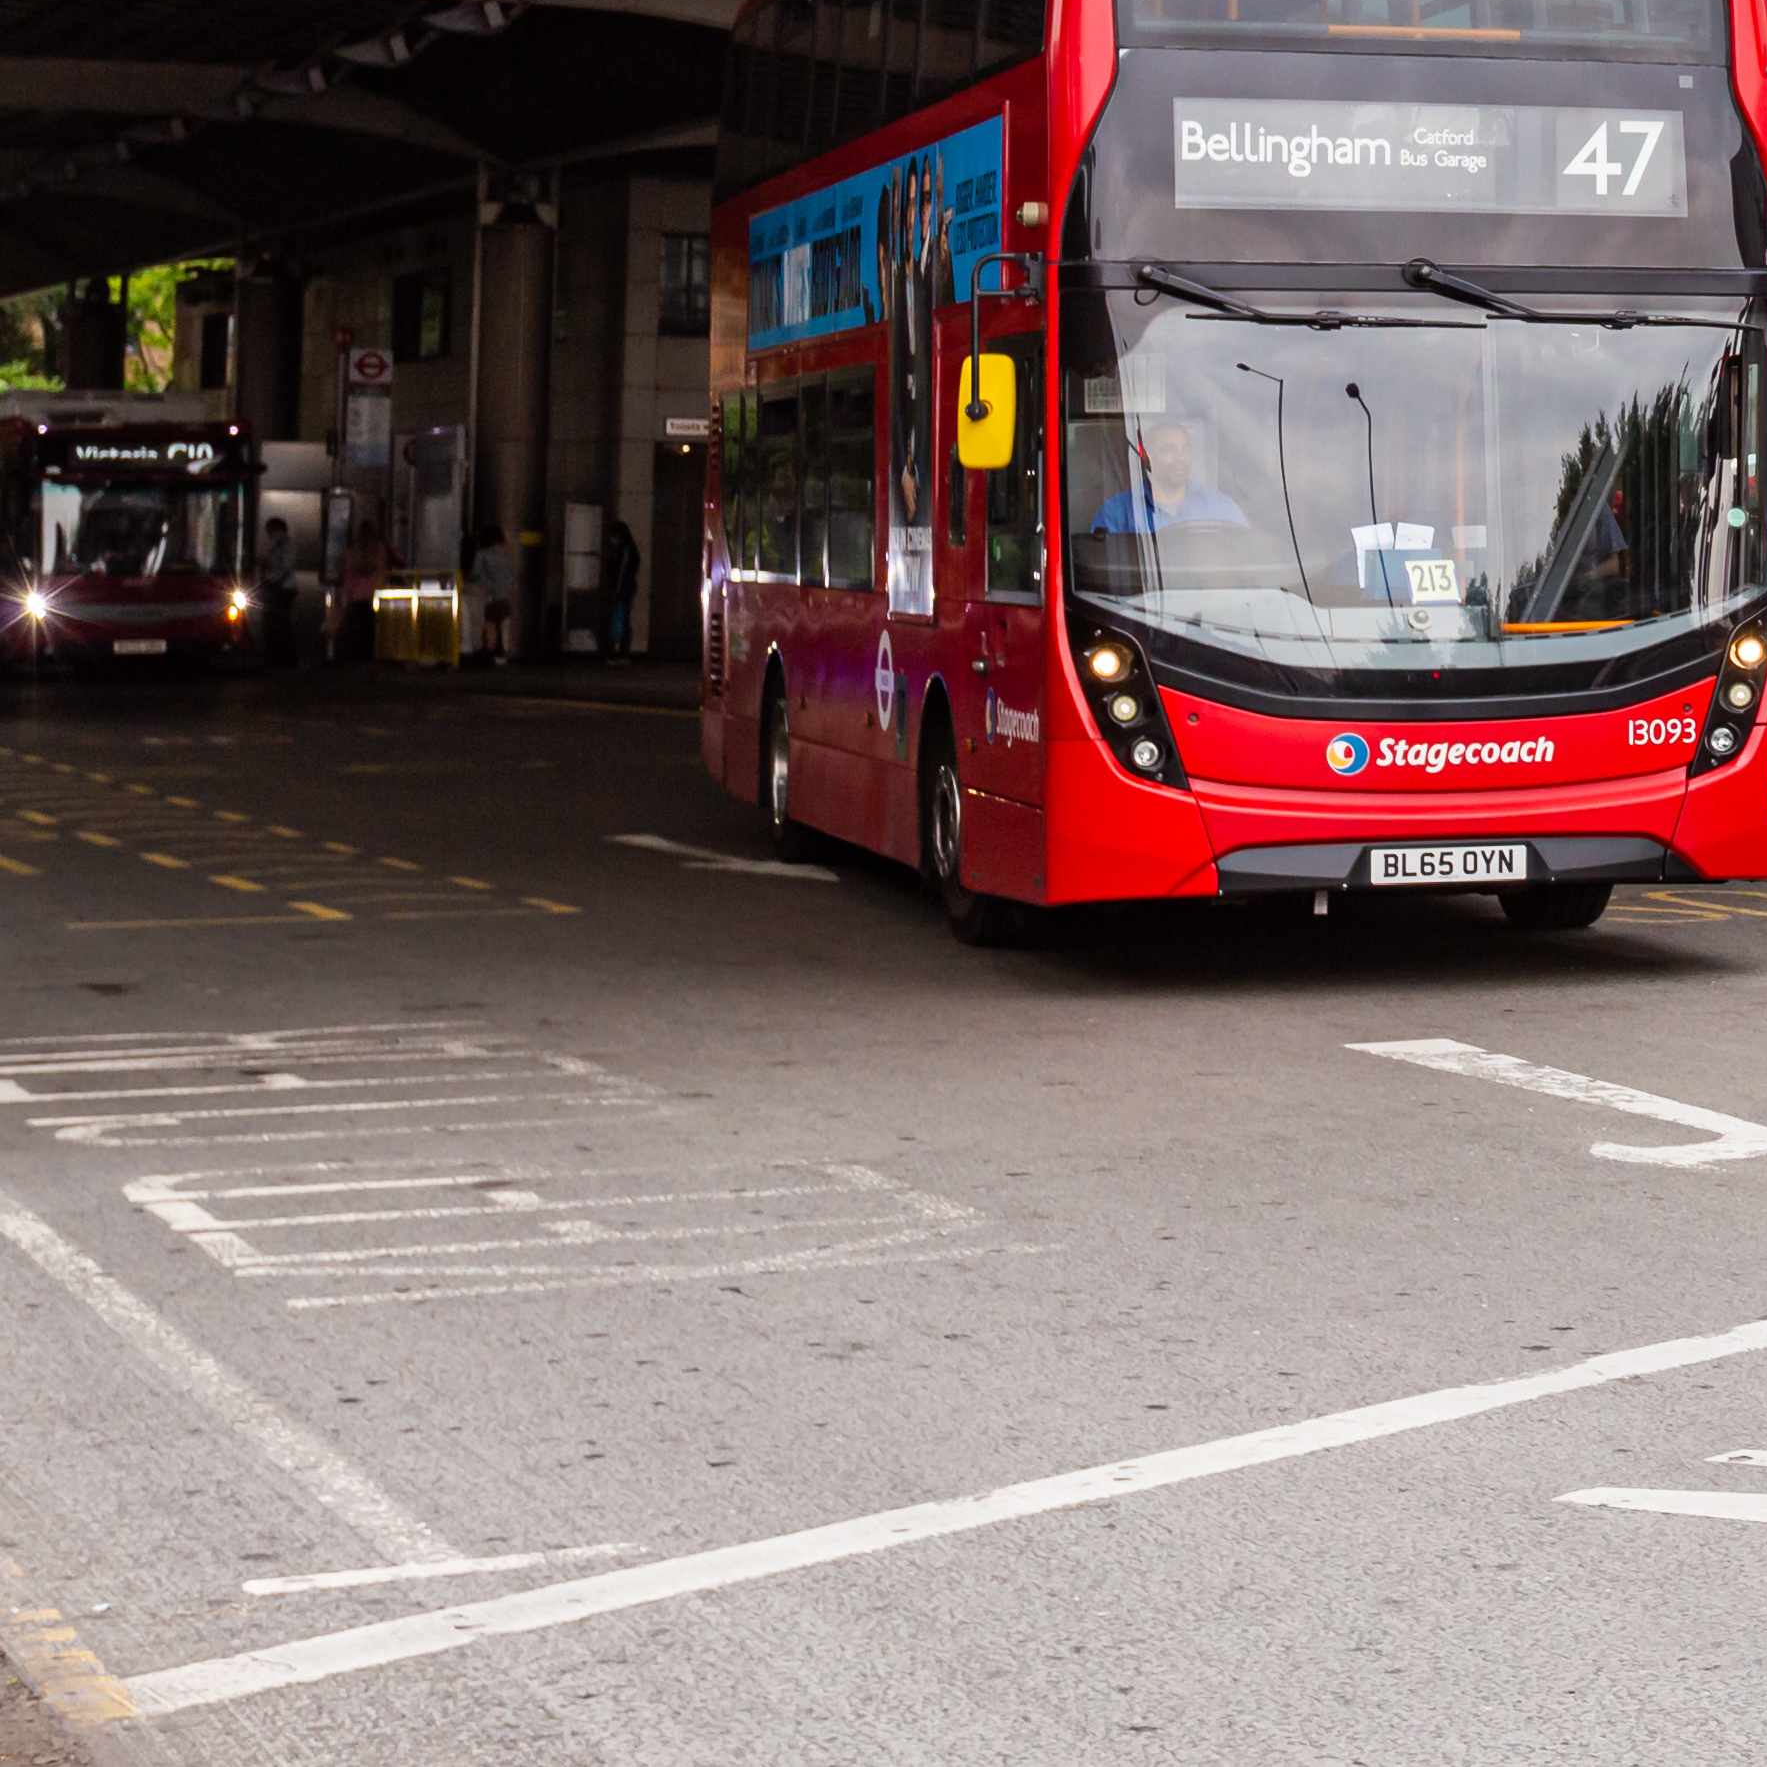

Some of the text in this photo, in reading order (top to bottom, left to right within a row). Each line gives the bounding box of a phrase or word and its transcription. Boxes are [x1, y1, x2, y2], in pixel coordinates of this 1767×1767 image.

[1181, 120, 1390, 177] Bellingham
[1413, 126, 1474, 146] Catford
[1400, 150, 1487, 172] Bus Garage
[1563, 120, 1665, 195] 47
[75, 445, 158, 460] Victoria
[1411, 563, 1453, 593] 213
[996, 695, 1039, 748] Stagecoach
[1628, 718, 1697, 746] 13093
[1376, 735, 1555, 774] Stagecoach
[1383, 849, 1515, 878] BL65 OYN
